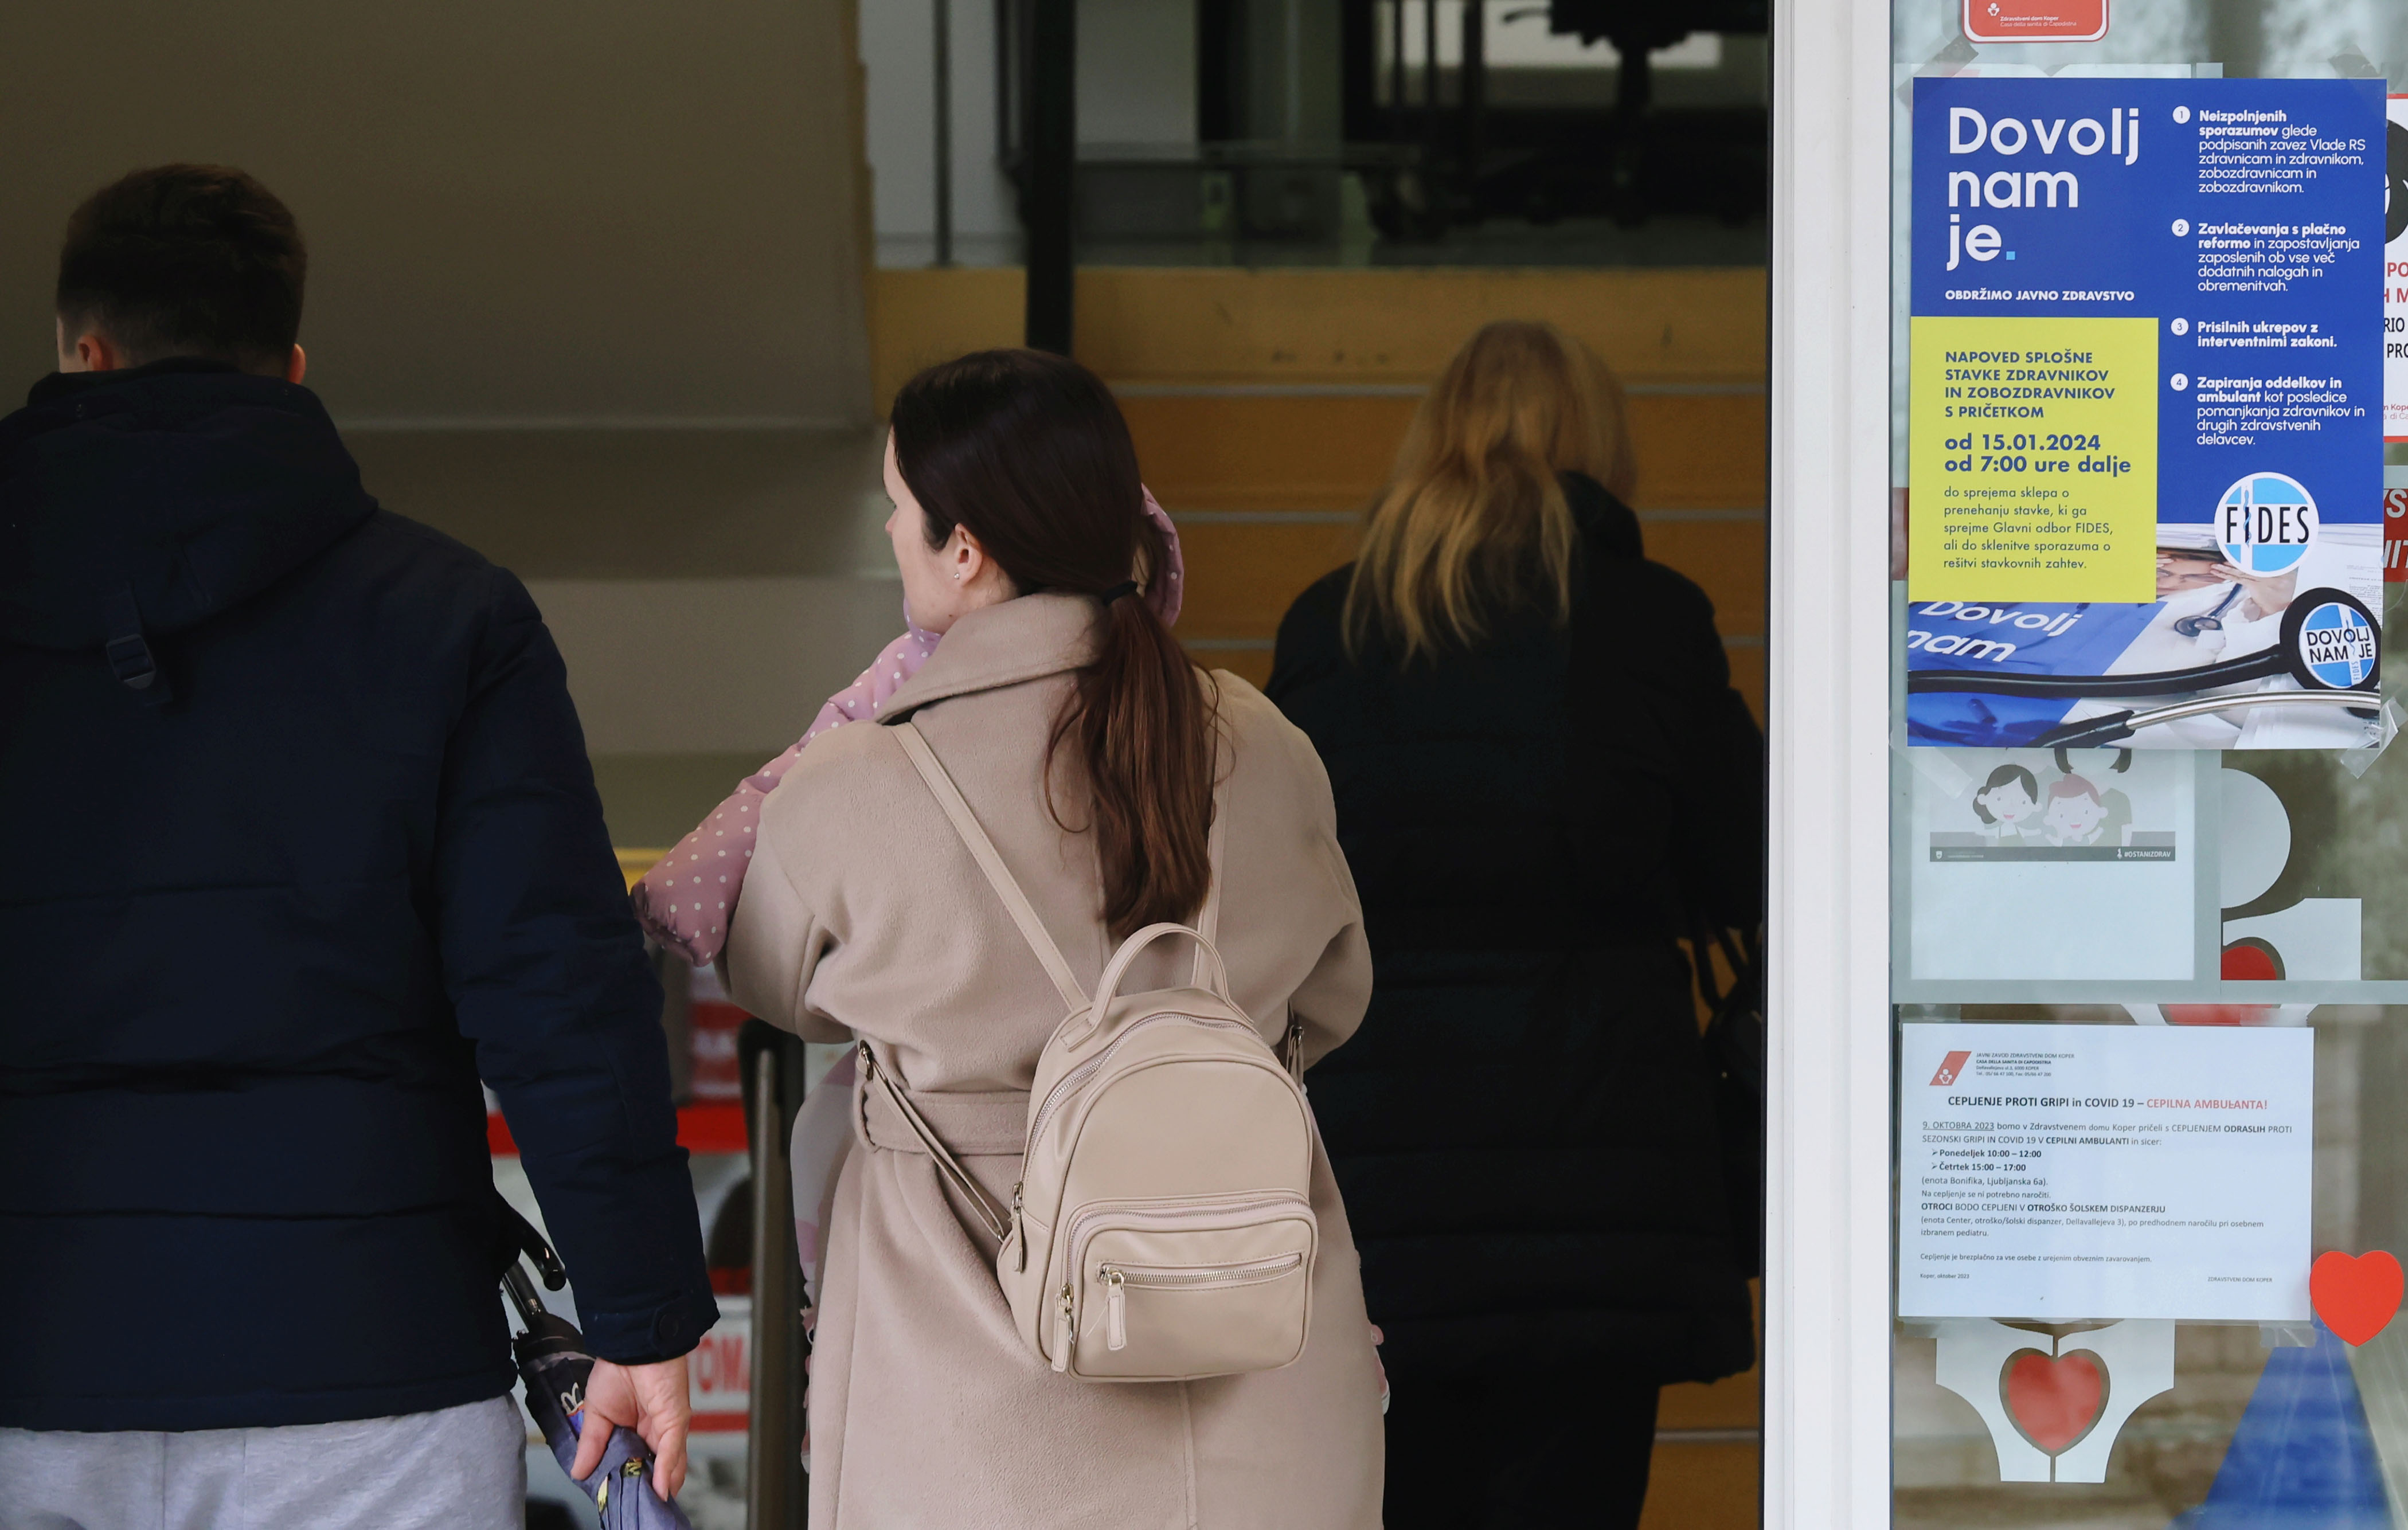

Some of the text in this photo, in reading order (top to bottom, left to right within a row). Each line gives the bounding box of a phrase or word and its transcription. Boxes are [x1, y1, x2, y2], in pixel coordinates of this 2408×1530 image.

[2199, 109, 2287, 125] Neizpolnjenih
[1949, 107, 2139, 166] Dovolj
[2199, 124, 2317, 140] sporazumov glede
[2199, 138, 2366, 154] podpisanih zavez Vlade RS
[2199, 152, 2364, 165] zdravnicam in zdravnikom,
[2198, 166, 2317, 179] zobozdravnicam in
[1948, 171, 2079, 209] nam
[2198, 180, 2304, 193] zobozdravnikom.
[2198, 222, 2289, 238] Zavlačevanja
[2292, 226, 2299, 235] s
[2301, 222, 2346, 238] plačno
[1946, 213, 2015, 272] je.
[2198, 236, 2360, 252] reformo in zapostavljanja
[2198, 251, 2335, 266] zaposlenih ob vse več
[2198, 265, 2323, 281] dodatnih nalogah in
[2198, 279, 2288, 291] obremenitvah.
[1945, 287, 2135, 302] OBDRŽIMO JAVNO ZDRAVSTVO
[2198, 320, 2250, 333] Prisilnih
[2253, 320, 2307, 336] ukrepov
[2311, 324, 2319, 333] z
[2197, 335, 2337, 347] interventnimi zakoni.
[1945, 348, 2093, 363] NAPOVED SPLOŠNE
[1945, 369, 2109, 382] STAVKE ZDRAVNIKOV
[2197, 376, 2262, 392] Zapiranja
[2265, 376, 2327, 389] oddelkov
[2329, 377, 2342, 389] in
[1945, 386, 2115, 400] IN ZOBOZDRAVNIKOV
[2197, 390, 2347, 406] ambulant kot posledice
[1945, 402, 2045, 418] S PRIČETKOM
[2197, 404, 2365, 420] pomanjkanja zdravnikov in
[2196, 418, 2321, 434] drugih zdravstvenih
[1945, 432, 2101, 451] od 15.01.2024
[2196, 432, 2255, 445] delavcev.
[1944, 453, 2131, 478] od 7:00 ure dalje
[1944, 486, 1960, 498] do
[1964, 487, 2016, 500] sprejema
[2020, 486, 2057, 501] sklepa
[1944, 503, 2087, 519] prenehanju stavke, ki ga
[1944, 521, 2113, 536] sprejme Glavni odbor FIDES,
[2226, 506, 2310, 544] FIDES
[1944, 538, 2110, 554] ali do sklenitve sporazuma o
[1944, 557, 2086, 569] rešitvi stavkovnih zahtev.
[1918, 601, 2083, 637] Dovolj
[2306, 627, 2370, 647] DOVOLJ
[1907, 630, 2016, 662] nam
[2309, 643, 2373, 663] NAM JE
[1948, 1096, 2003, 1106] CEPLJENJE
[2005, 1097, 2038, 1107] PROTI
[2040, 1097, 2069, 1108] GRIPI
[2072, 1097, 2082, 1108] in
[2085, 1097, 2119, 1108] COVID
[2122, 1098, 2135, 1108] 19
[2147, 1098, 2191, 1109] CEPILNA
[1922, 1121, 1930, 1129] 9.
[1933, 1121, 1972, 1130] OKTOBRA
[1975, 1122, 1995, 1130] 2023
[1997, 1122, 2020, 1130] bomo
[2030, 1122, 2086, 1130] Zdravstvenem
[2112, 1124, 2136, 1133] Koper
[2139, 1124, 2163, 1133] pričeli
[2172, 1124, 2221, 1132] CEPLJENJEM
[2223, 1125, 2266, 1133] ODRASLIH
[1922, 1134, 1961, 1143] SEZONSKI
[1963, 1135, 1985, 1144] GRIPI
[1987, 1136, 1996, 1144] IN
[1997, 1136, 2024, 1144] COVID
[2026, 1136, 2036, 1144] 19
[2038, 1136, 2045, 1144] V
[2046, 1136, 2077, 1145] CEPILNI
[2078, 1137, 2129, 1145] AMBULANTI
[2131, 1137, 2139, 1145] in
[1939, 1149, 2042, 1159] Ponedeljek 10:00 12:00
[1939, 1160, 2026, 1172] Četrtek 15:00 17:00
[1921, 1176, 2048, 1187] (enota Bonifika, Ljubljanska 6a).
[1933, 1190, 1966, 1199] cepljenje
[1986, 1190, 2020, 1199] potrebno
[2022, 1191, 2051, 1199] naročiti.
